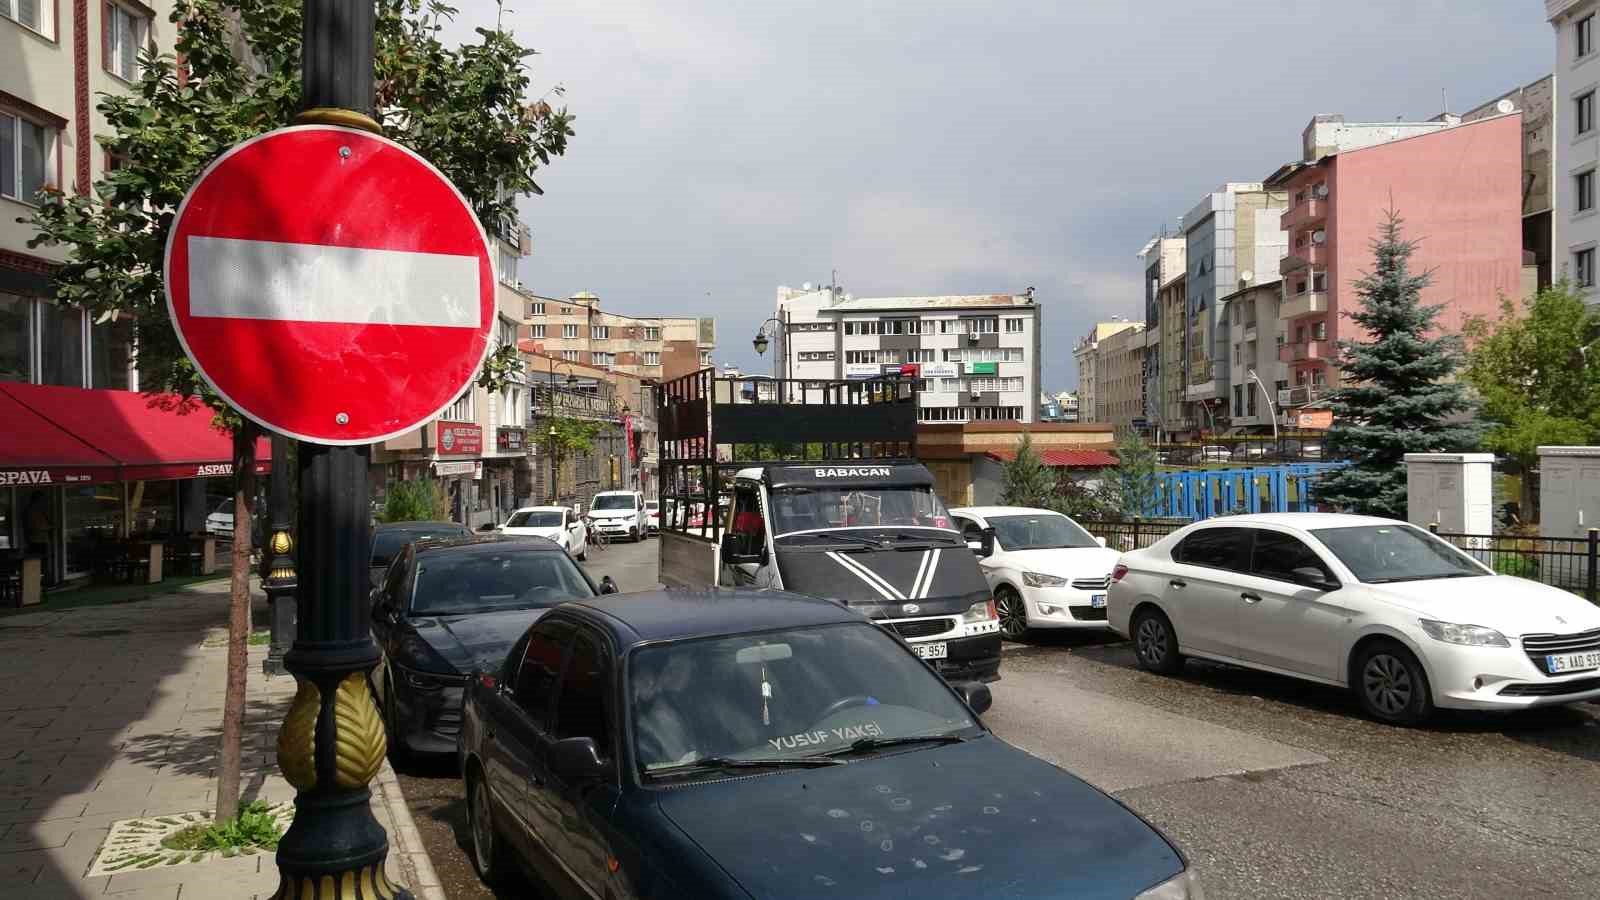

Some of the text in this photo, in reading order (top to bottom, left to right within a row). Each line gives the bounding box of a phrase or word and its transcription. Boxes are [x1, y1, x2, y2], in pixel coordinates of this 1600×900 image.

[197, 464, 233, 476] ASPAV
[815, 468, 890, 478] BABACAN
[928, 645, 946, 657] 957
[1554, 656, 1565, 670] 25
[768, 730, 829, 751] YUSUF
